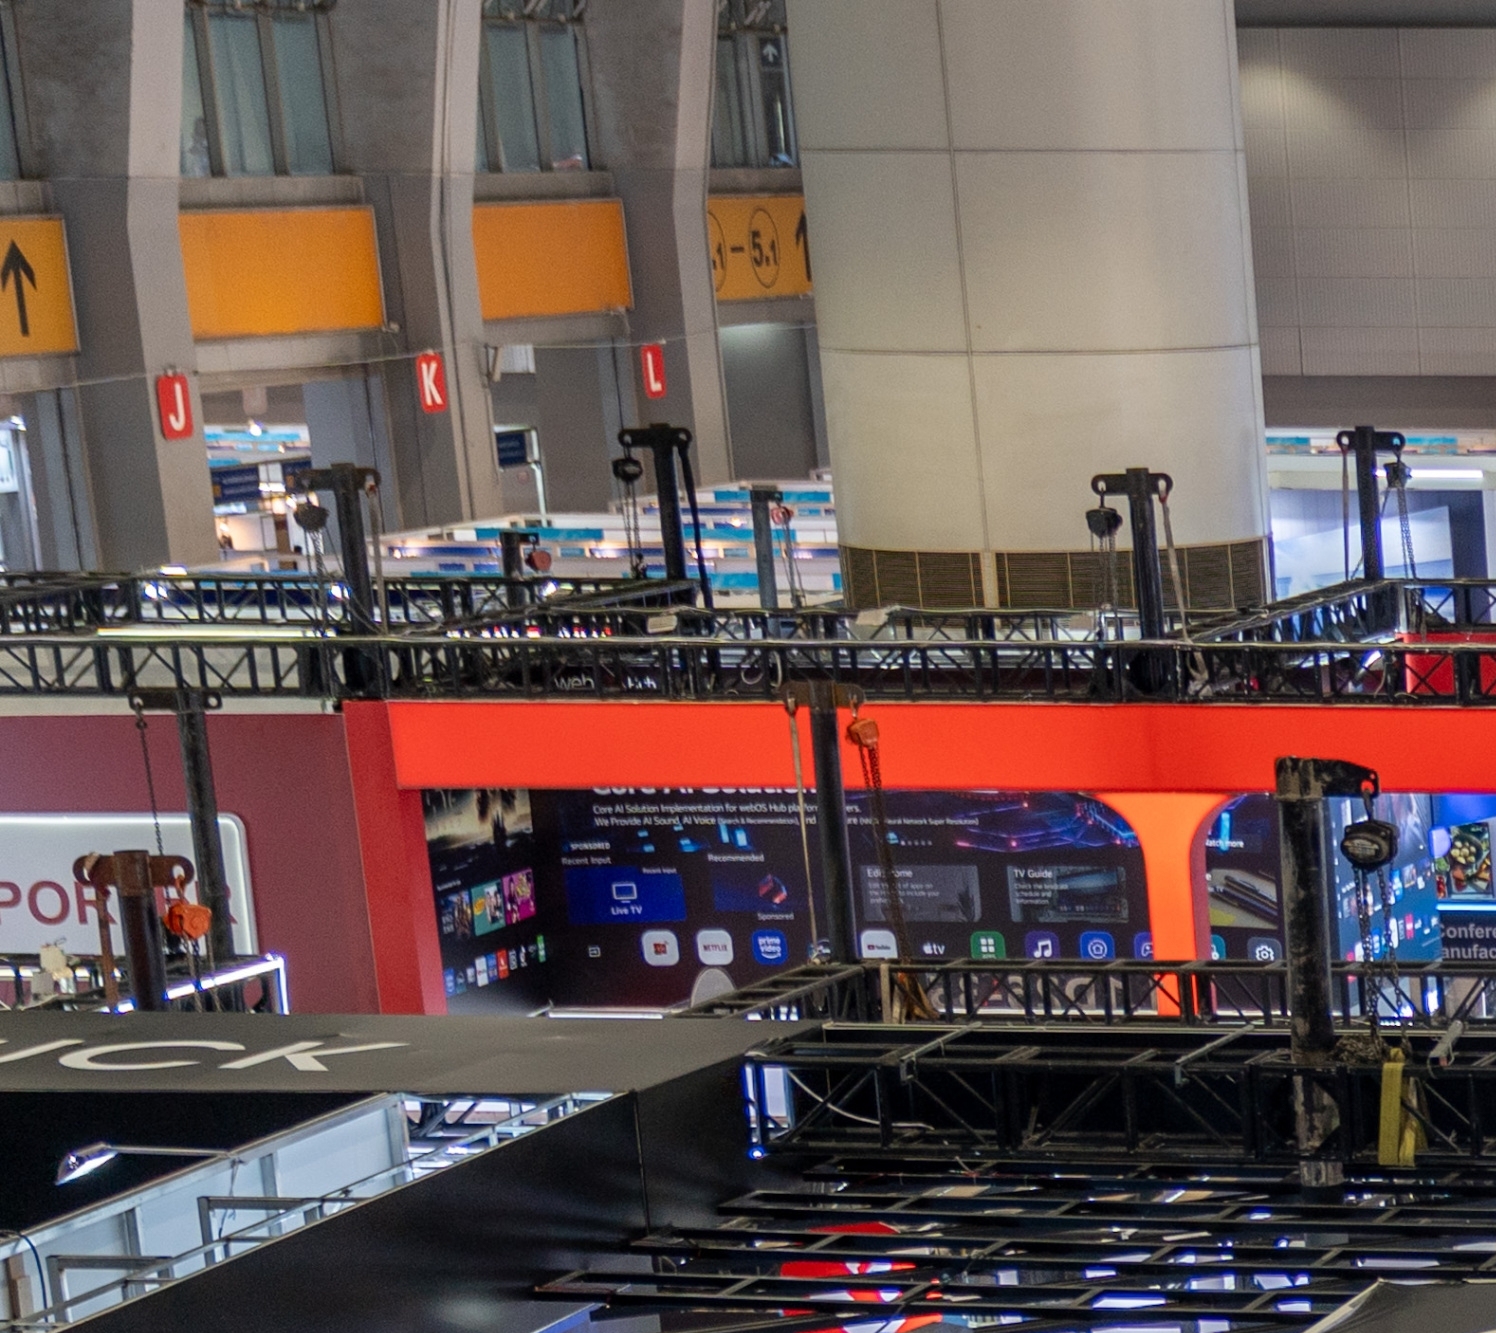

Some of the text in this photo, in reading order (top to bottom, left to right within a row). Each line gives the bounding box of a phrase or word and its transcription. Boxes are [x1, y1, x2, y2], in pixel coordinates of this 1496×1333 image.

[750, 228, 779, 268] 5.1
[648, 350, 663, 394] L
[420, 362, 442, 407] K
[169, 386, 187, 432] J
[592, 803, 613, 815] Core
[614, 803, 624, 814] AI
[625, 802, 659, 814] Solution
[660, 802, 723, 816] Implementation
[725, 802, 737, 814] for
[768, 802, 786, 814] Hub
[595, 815, 716, 828] We Provide AI Sound, AI Voice
[570, 841, 611, 851] SPONSORED
[1225, 839, 1244, 849] more
[561, 855, 612, 867] Recent Input
[708, 852, 765, 864] Recommended
[1013, 868, 1054, 879] TV Guide
[611, 905, 643, 916] Live TV
[756, 911, 795, 922] Sponsored
[757, 936, 782, 947] prime
[702, 943, 728, 953] NETFLIX
[758, 944, 781, 954] video
[934, 943, 946, 955] tv
